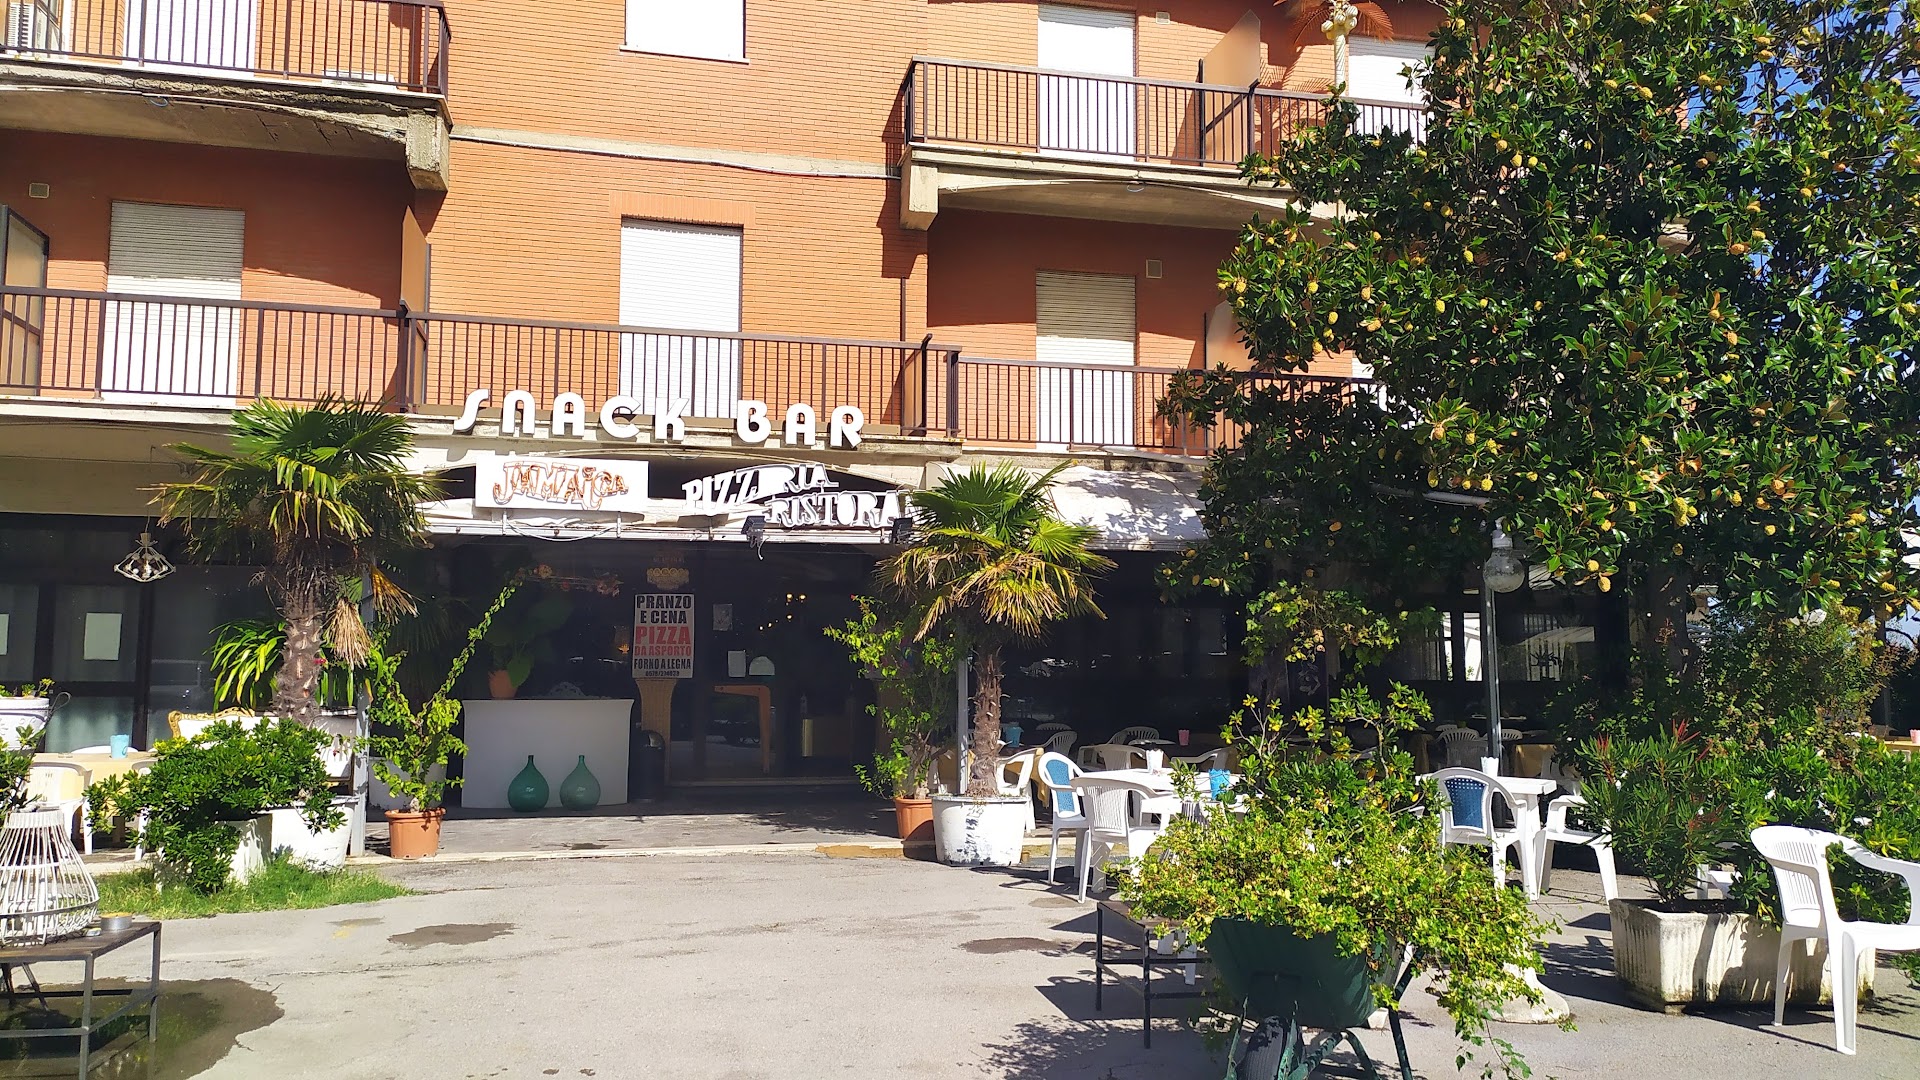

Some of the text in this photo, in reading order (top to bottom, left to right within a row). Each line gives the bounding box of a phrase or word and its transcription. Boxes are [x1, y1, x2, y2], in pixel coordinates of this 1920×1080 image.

[453, 389, 865, 448] SNACK BAR
[493, 461, 629, 510] JAMAICA
[636, 595, 692, 609] PRANZO
[640, 610, 687, 624] E CENA
[635, 626, 691, 645] PIZZA
[634, 646, 692, 656] DA ASPORTO
[634, 658, 691, 670] FORNO A LEGNA
